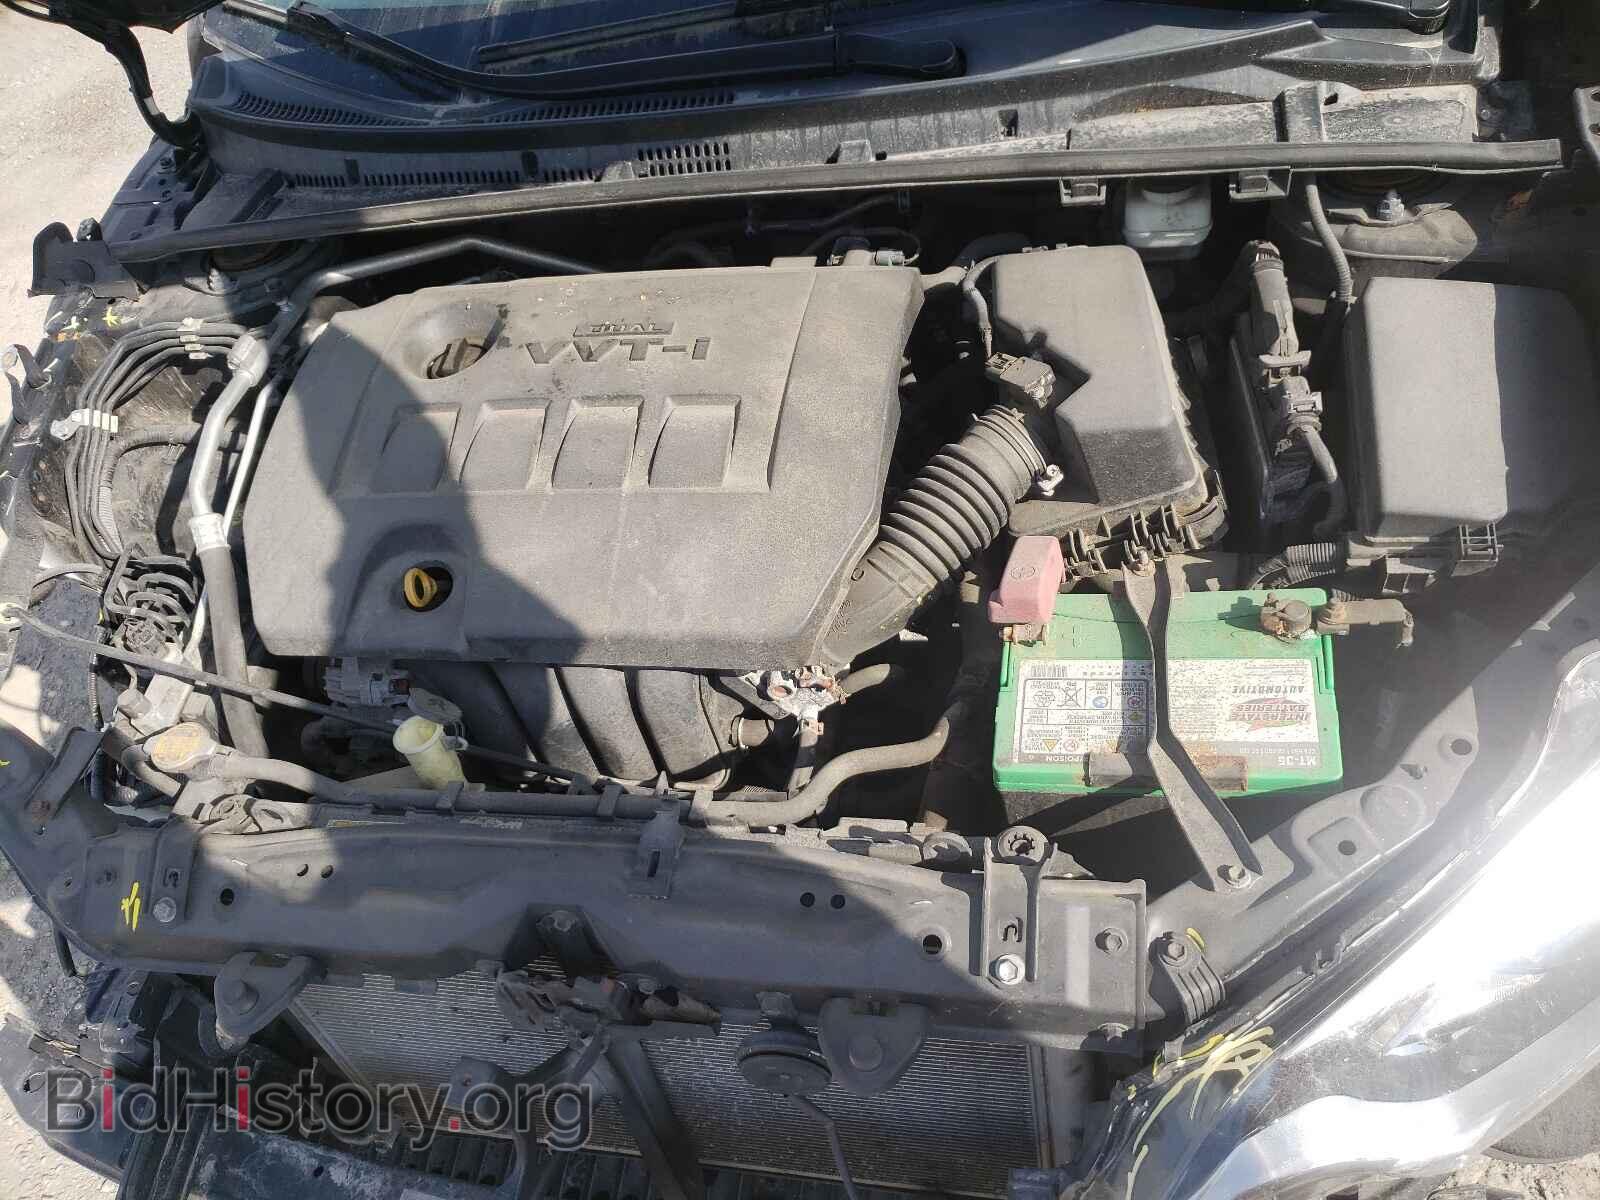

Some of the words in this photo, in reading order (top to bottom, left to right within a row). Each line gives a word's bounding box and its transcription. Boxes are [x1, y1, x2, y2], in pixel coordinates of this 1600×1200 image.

[1231, 685, 1304, 694] AUTOMOTIVE
[1235, 704, 1306, 712] BATTERIES
[1229, 713, 1309, 721] INTERSTATE
